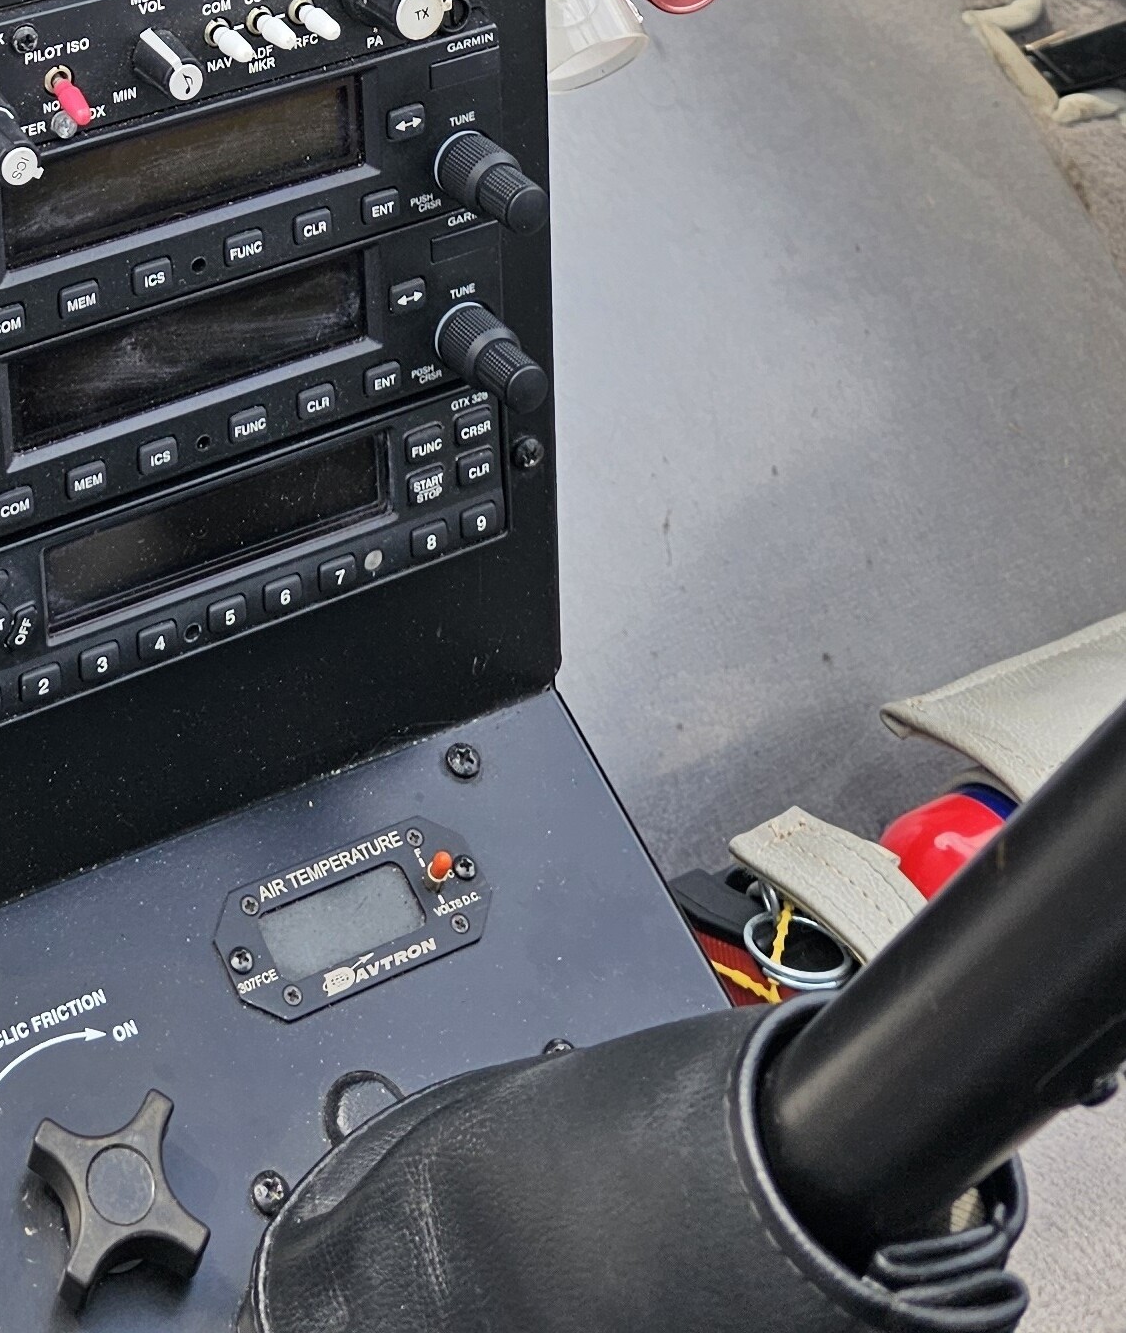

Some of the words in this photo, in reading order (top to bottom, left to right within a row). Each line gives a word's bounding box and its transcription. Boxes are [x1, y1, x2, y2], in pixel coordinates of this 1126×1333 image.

[137, 0, 166, 14] VOL
[24, 44, 63, 65] PILOT
[65, 38, 90, 54] ISO
[446, 33, 494, 53] GARMIN
[449, 111, 476, 127] TUNE
[303, 221, 327, 238] CLR
[230, 240, 263, 261] FUNC
[67, 292, 96, 312] MEM
[461, 420, 492, 439] CRSR
[258, 873, 287, 902] AIR
[286, 831, 403, 889] TEMPERATURE
[31, 988, 108, 1035] FRICTION
[112, 1020, 139, 1042] ON
